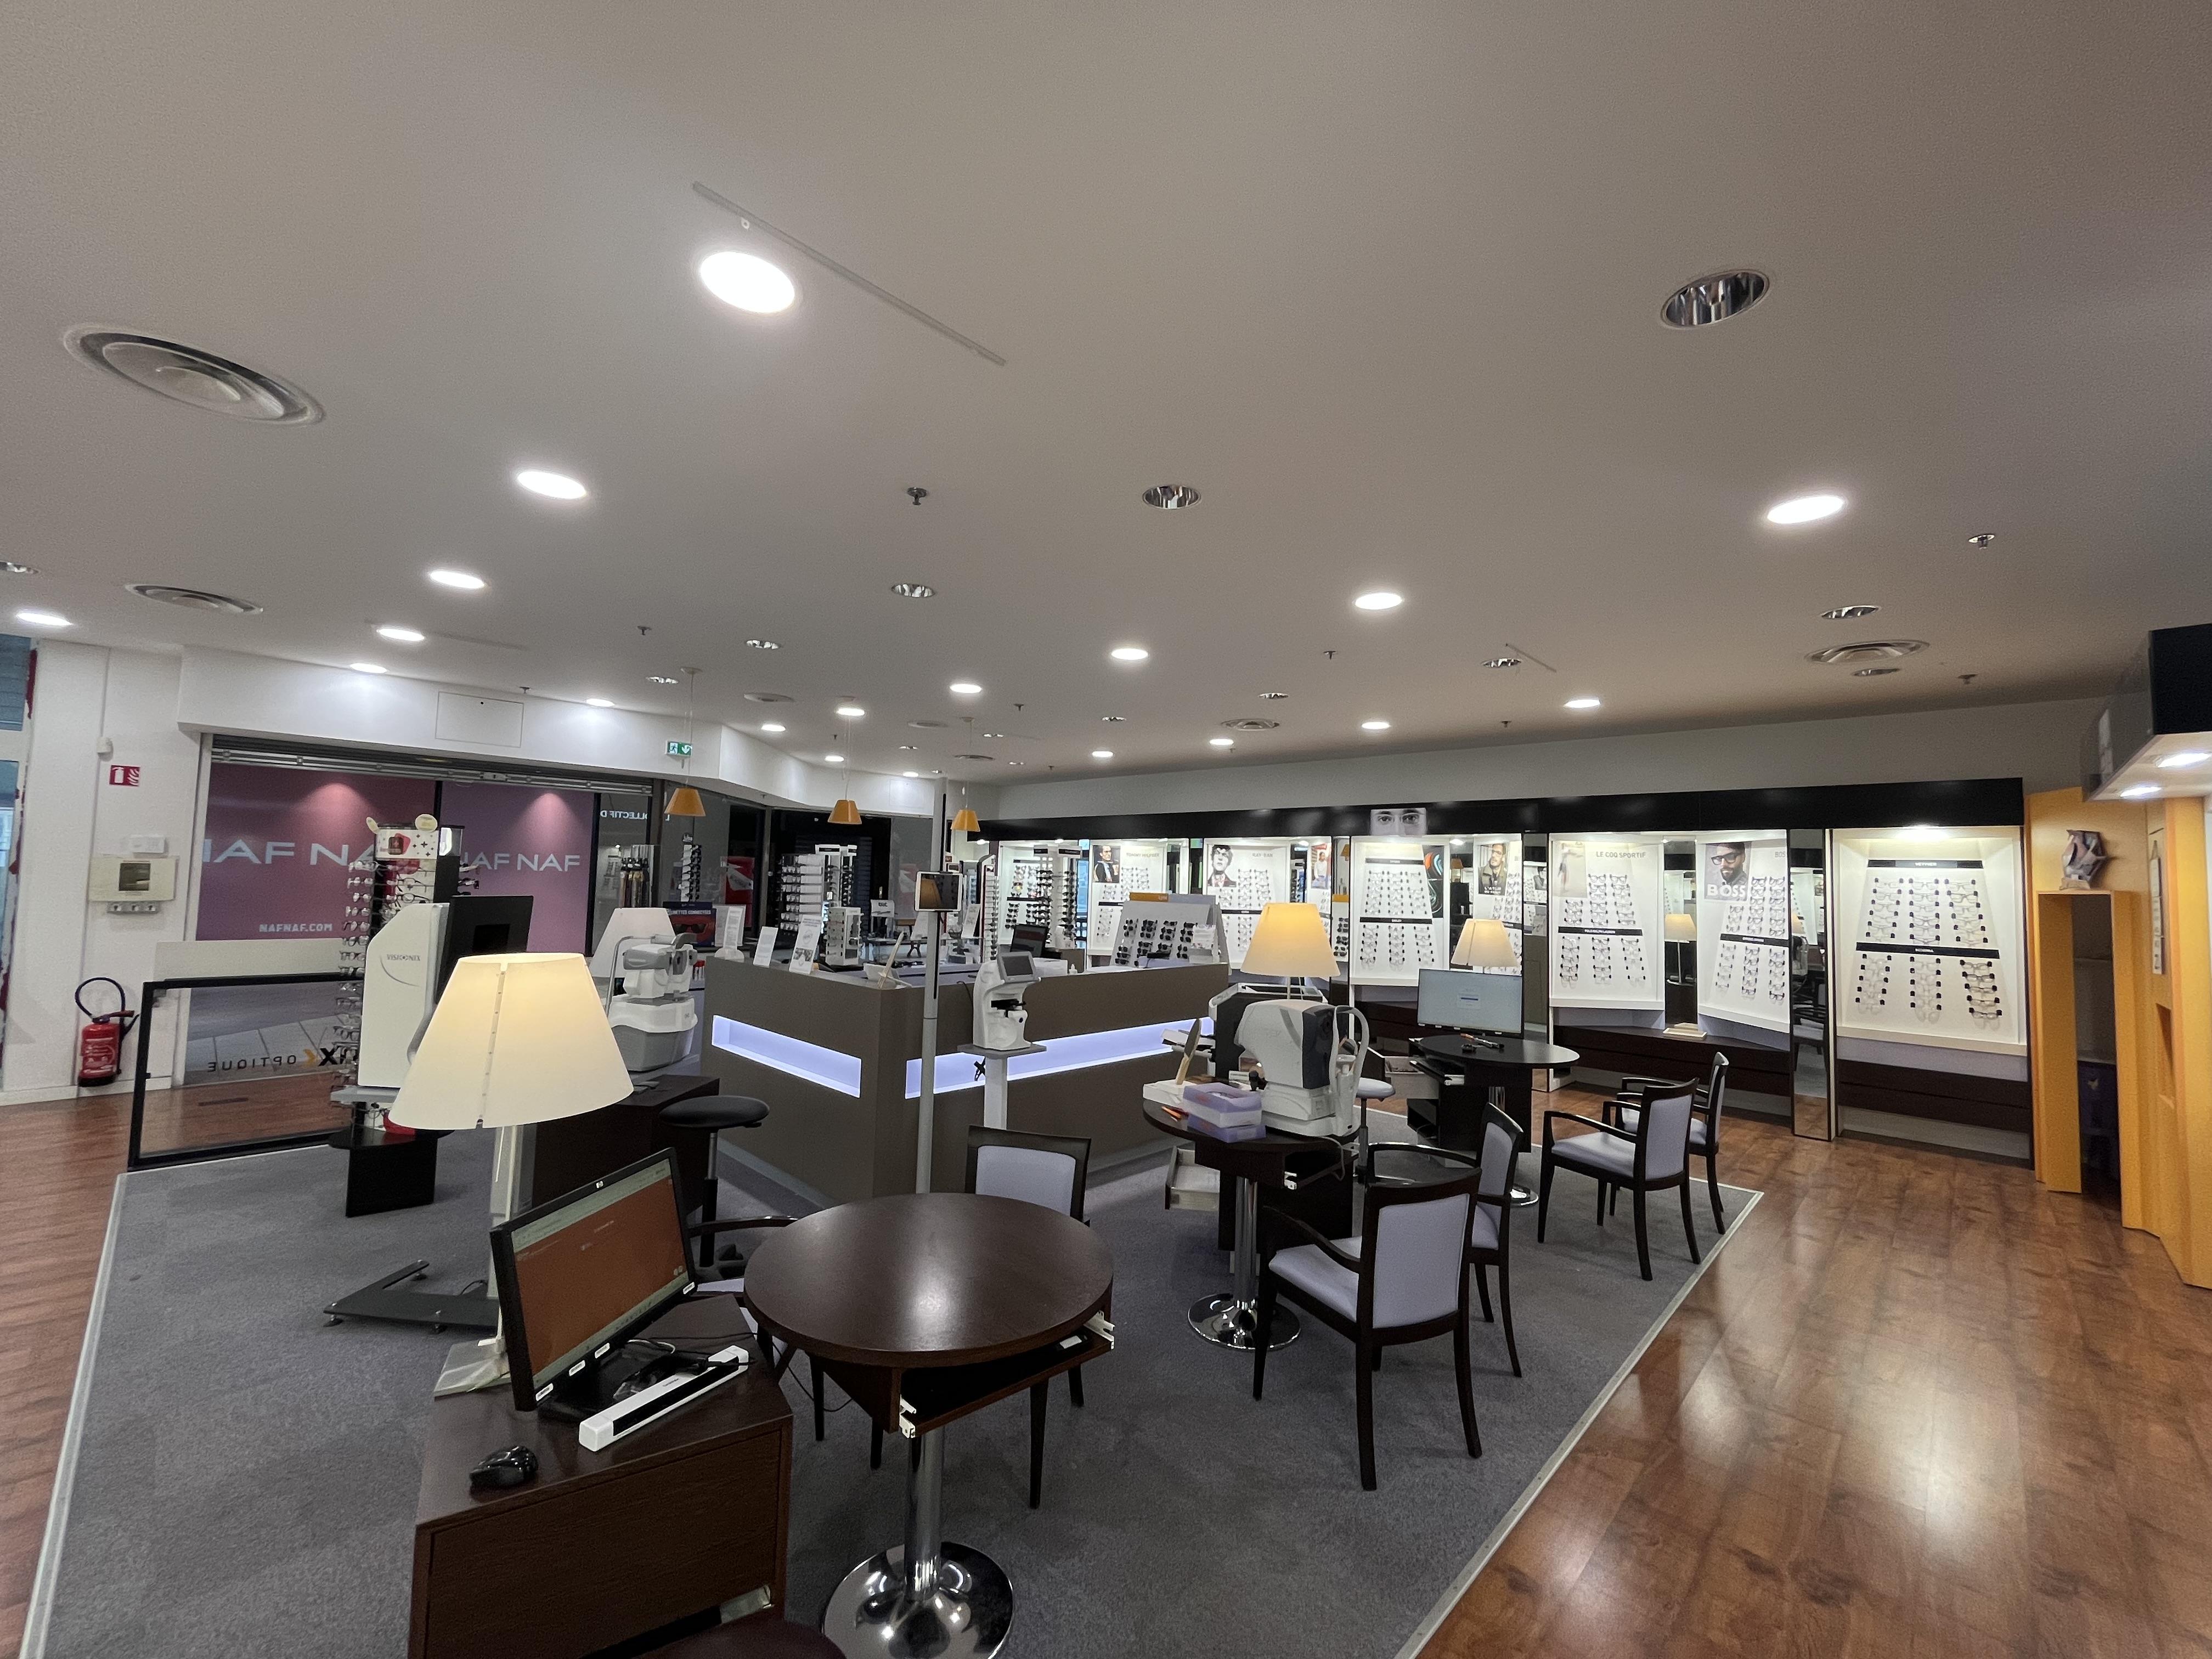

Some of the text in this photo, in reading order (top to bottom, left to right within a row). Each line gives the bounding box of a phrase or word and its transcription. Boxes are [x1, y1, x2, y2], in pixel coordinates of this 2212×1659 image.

[517, 853, 580, 872] NAF
[1707, 884, 1746, 898] BOSS
[259, 923, 332, 933] NAFNAF.COM
